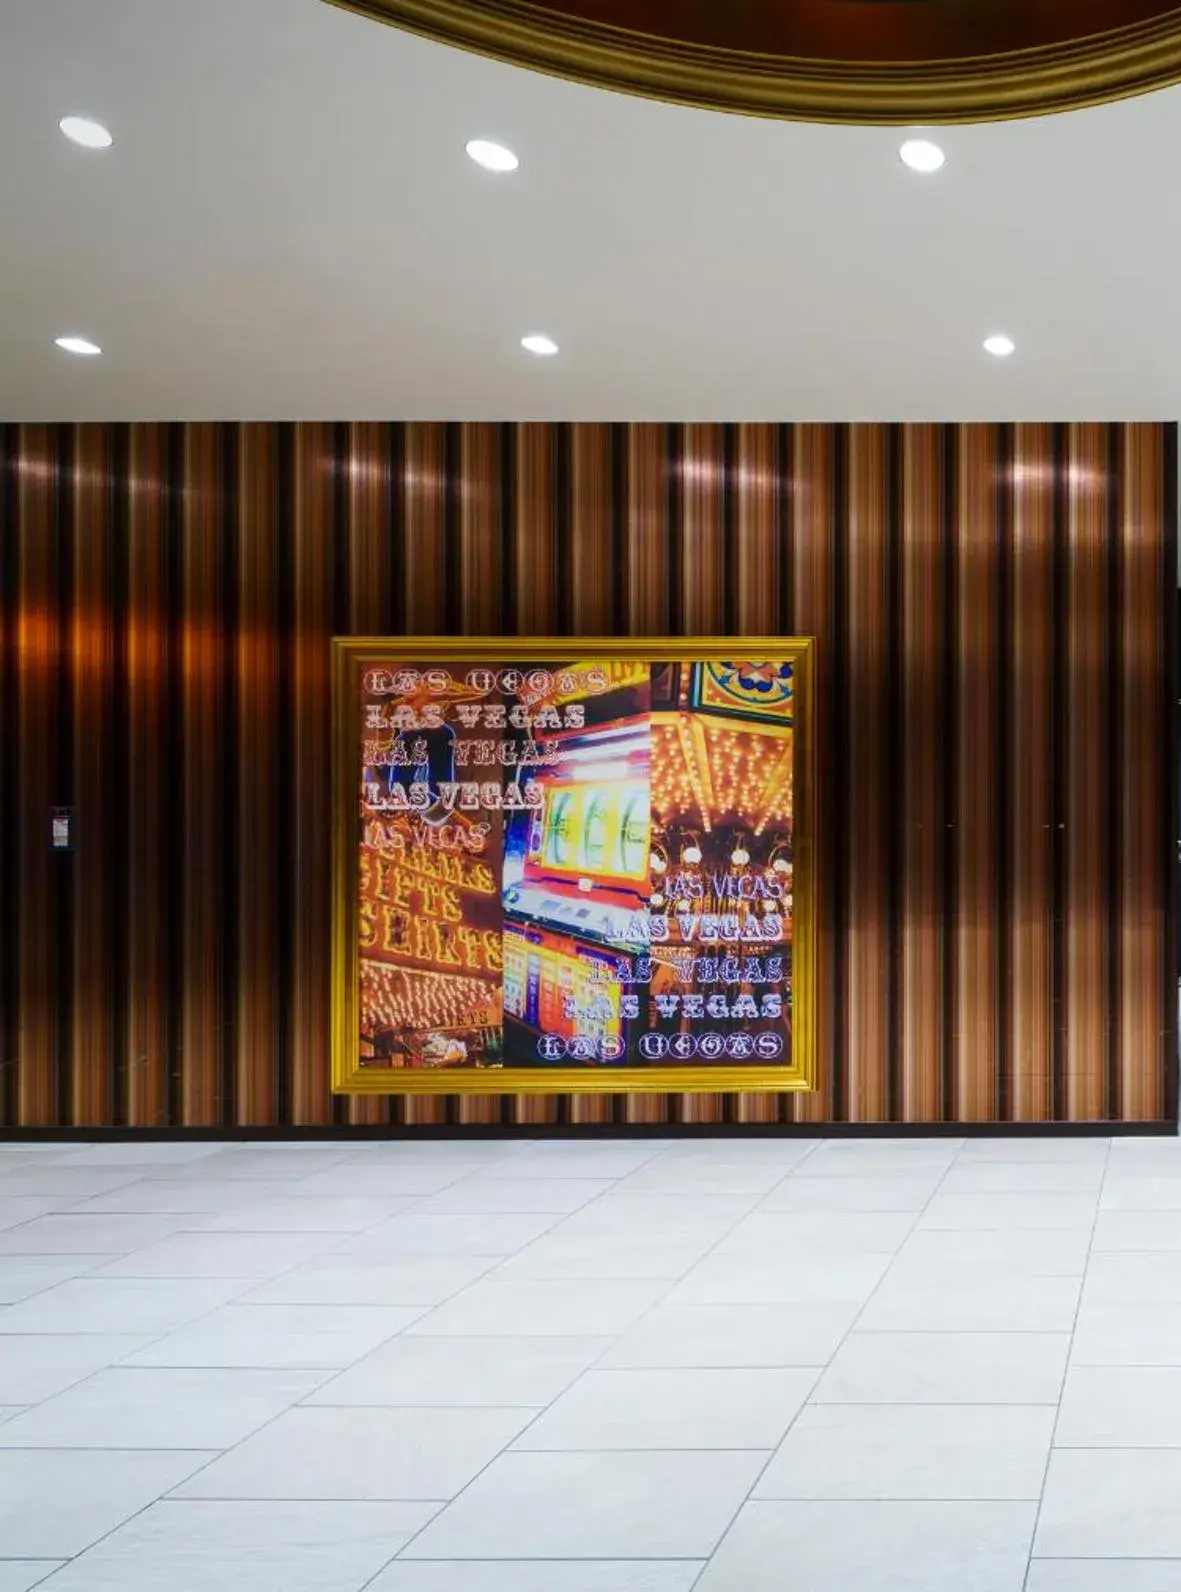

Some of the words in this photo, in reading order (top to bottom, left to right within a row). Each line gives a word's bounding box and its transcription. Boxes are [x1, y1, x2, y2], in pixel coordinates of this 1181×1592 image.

[364, 669, 451, 695] LAS
[366, 705, 442, 728] LAS
[456, 705, 585, 728] VEGAS
[364, 740, 428, 766] LAS
[452, 740, 559, 766] VEGAS
[364, 782, 430, 809] LAS
[437, 782, 544, 810] VEGAS
[363, 825, 407, 849] LAS
[665, 875, 704, 899] LAS
[602, 914, 670, 941] LAS
[677, 913, 783, 941] VEGAS
[589, 957, 652, 983] LAS
[676, 957, 783, 983] VEGAS
[563, 995, 640, 1018] LAS
[654, 995, 782, 1018] VEGAS
